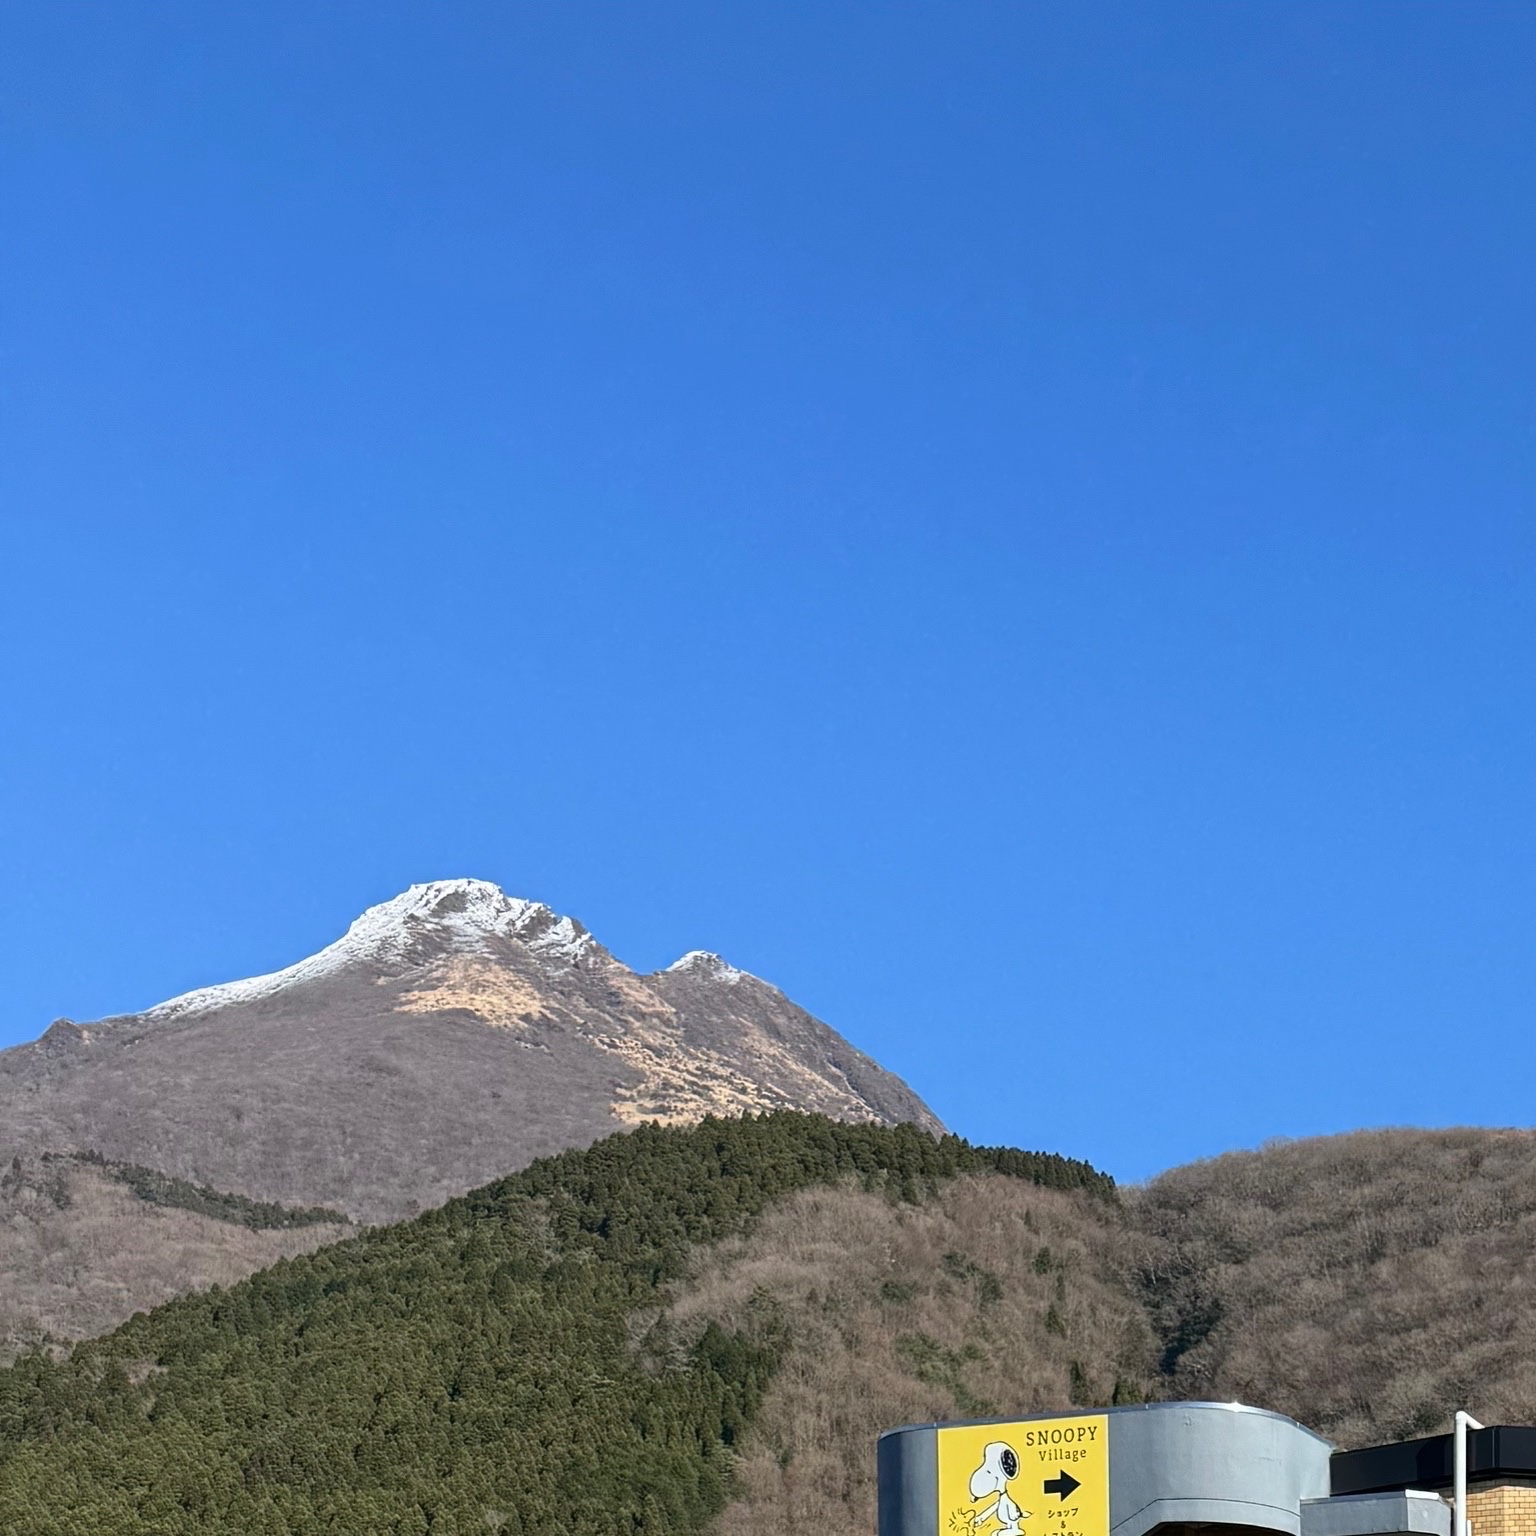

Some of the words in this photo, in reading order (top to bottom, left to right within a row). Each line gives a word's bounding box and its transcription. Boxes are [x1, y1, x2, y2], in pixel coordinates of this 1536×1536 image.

[1026, 1426, 1098, 1446] SNOOPY
[1039, 1448, 1087, 1462] Village
[1048, 1507, 1079, 1519] ショップ
